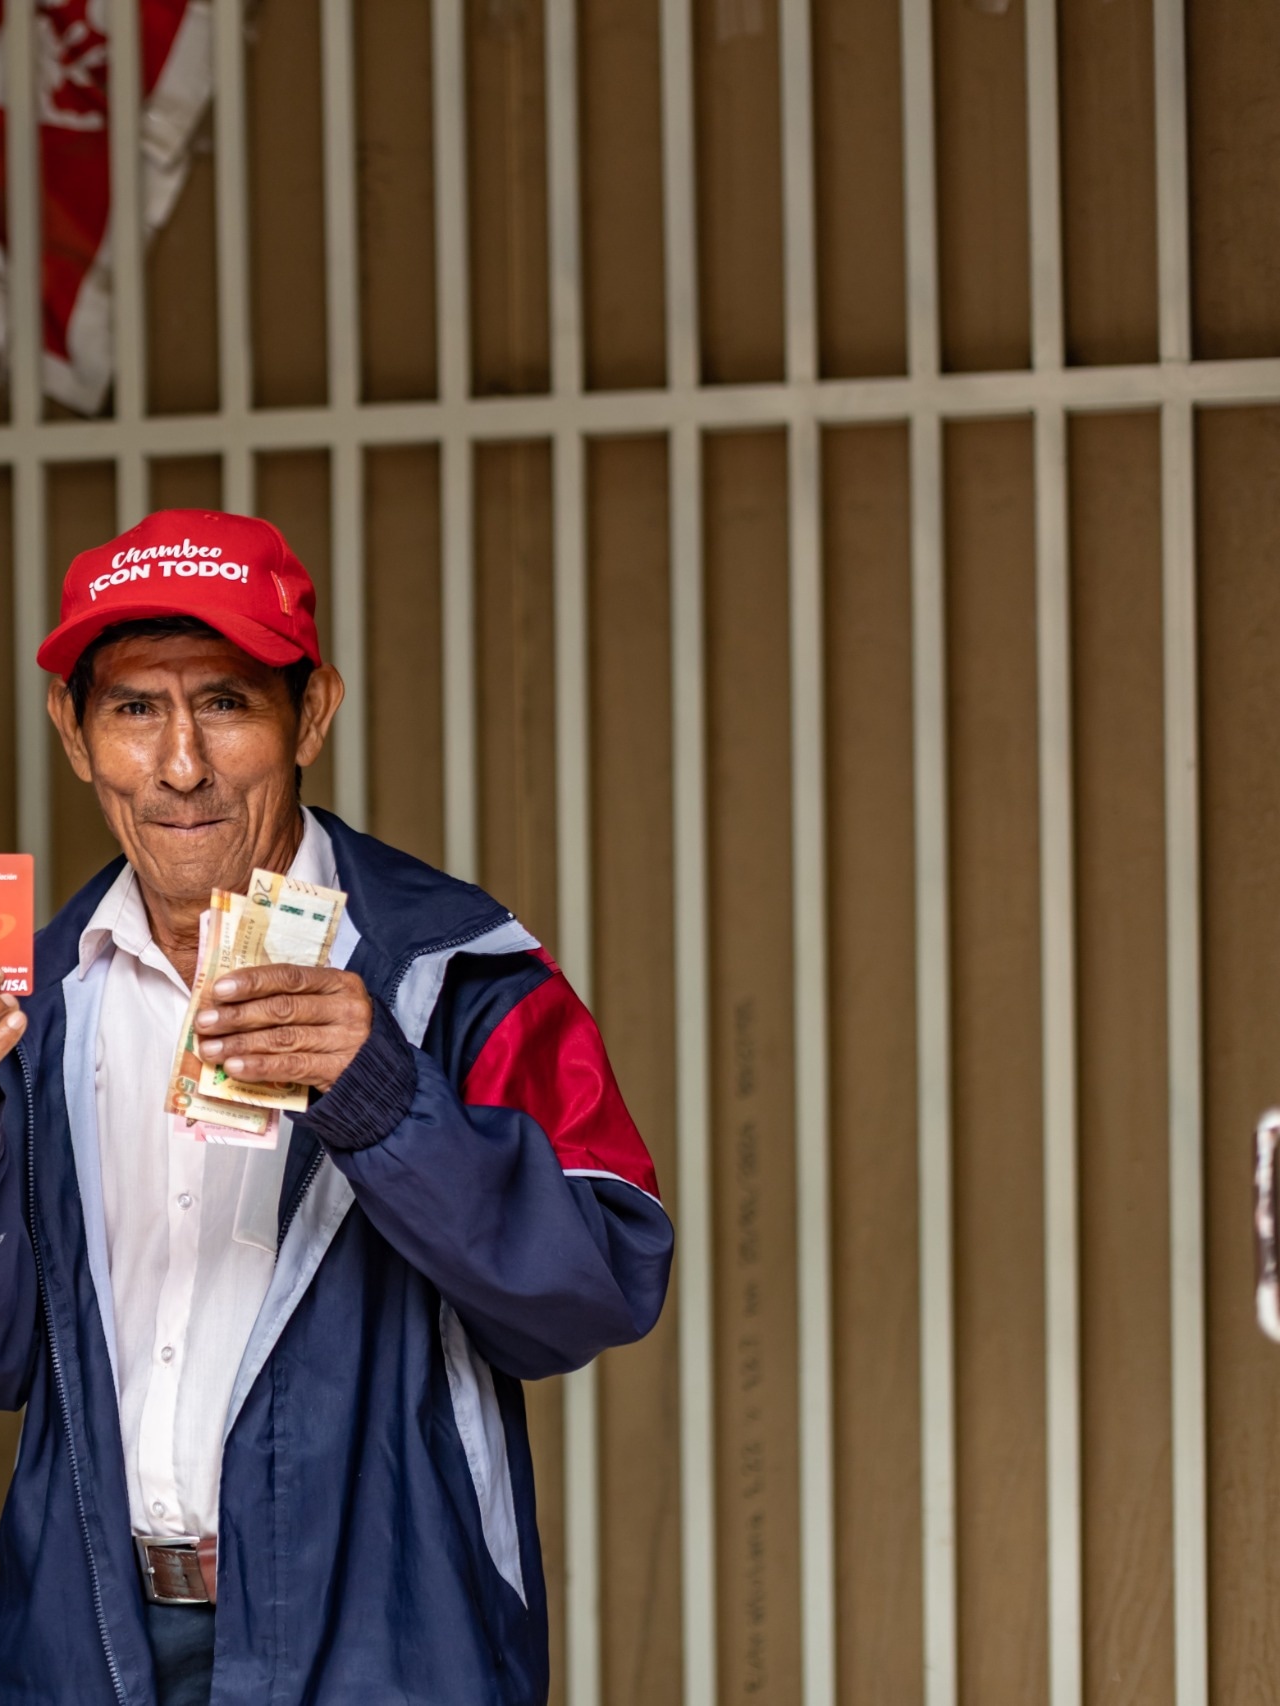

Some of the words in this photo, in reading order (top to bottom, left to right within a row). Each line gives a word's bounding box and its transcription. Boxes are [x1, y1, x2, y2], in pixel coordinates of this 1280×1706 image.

[112, 538, 222, 570] Chambeo
[88, 563, 150, 601] ¡CON
[158, 561, 249, 583] TODO!
[0, 965, 17, 973] bito
